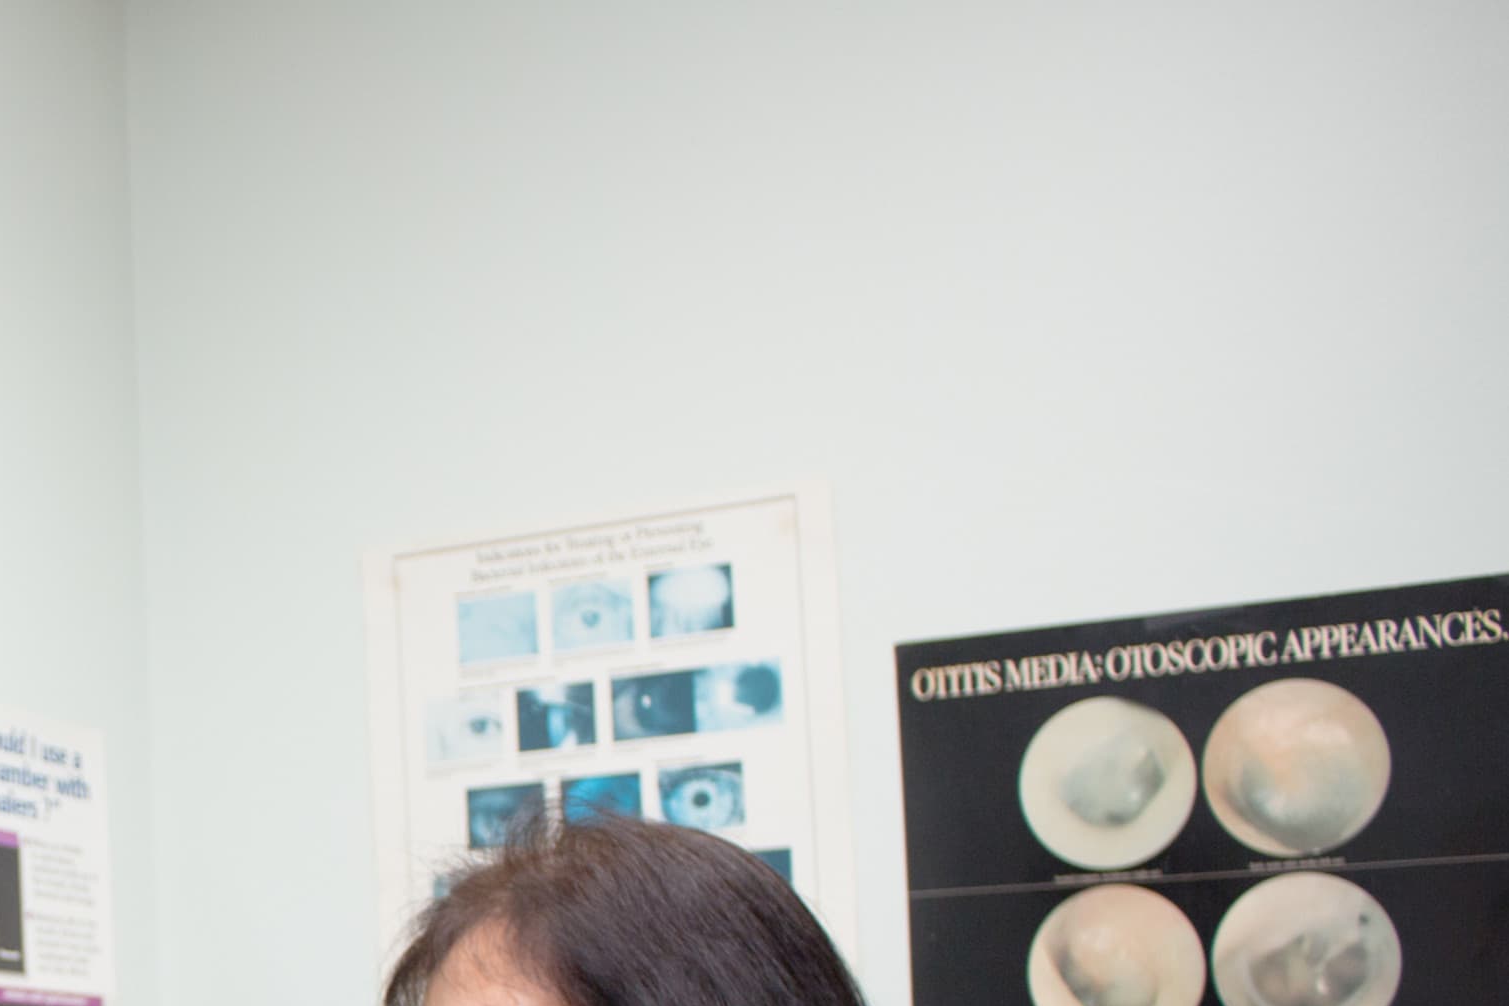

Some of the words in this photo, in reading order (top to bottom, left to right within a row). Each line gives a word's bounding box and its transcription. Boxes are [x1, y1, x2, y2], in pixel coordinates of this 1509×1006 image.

[910, 659, 1003, 702] OTITIS
[1003, 649, 1103, 693] MEDIA:
[1103, 630, 1278, 684] OTOSCOPIC
[42, 744, 68, 766] use
[55, 776, 91, 801] with
